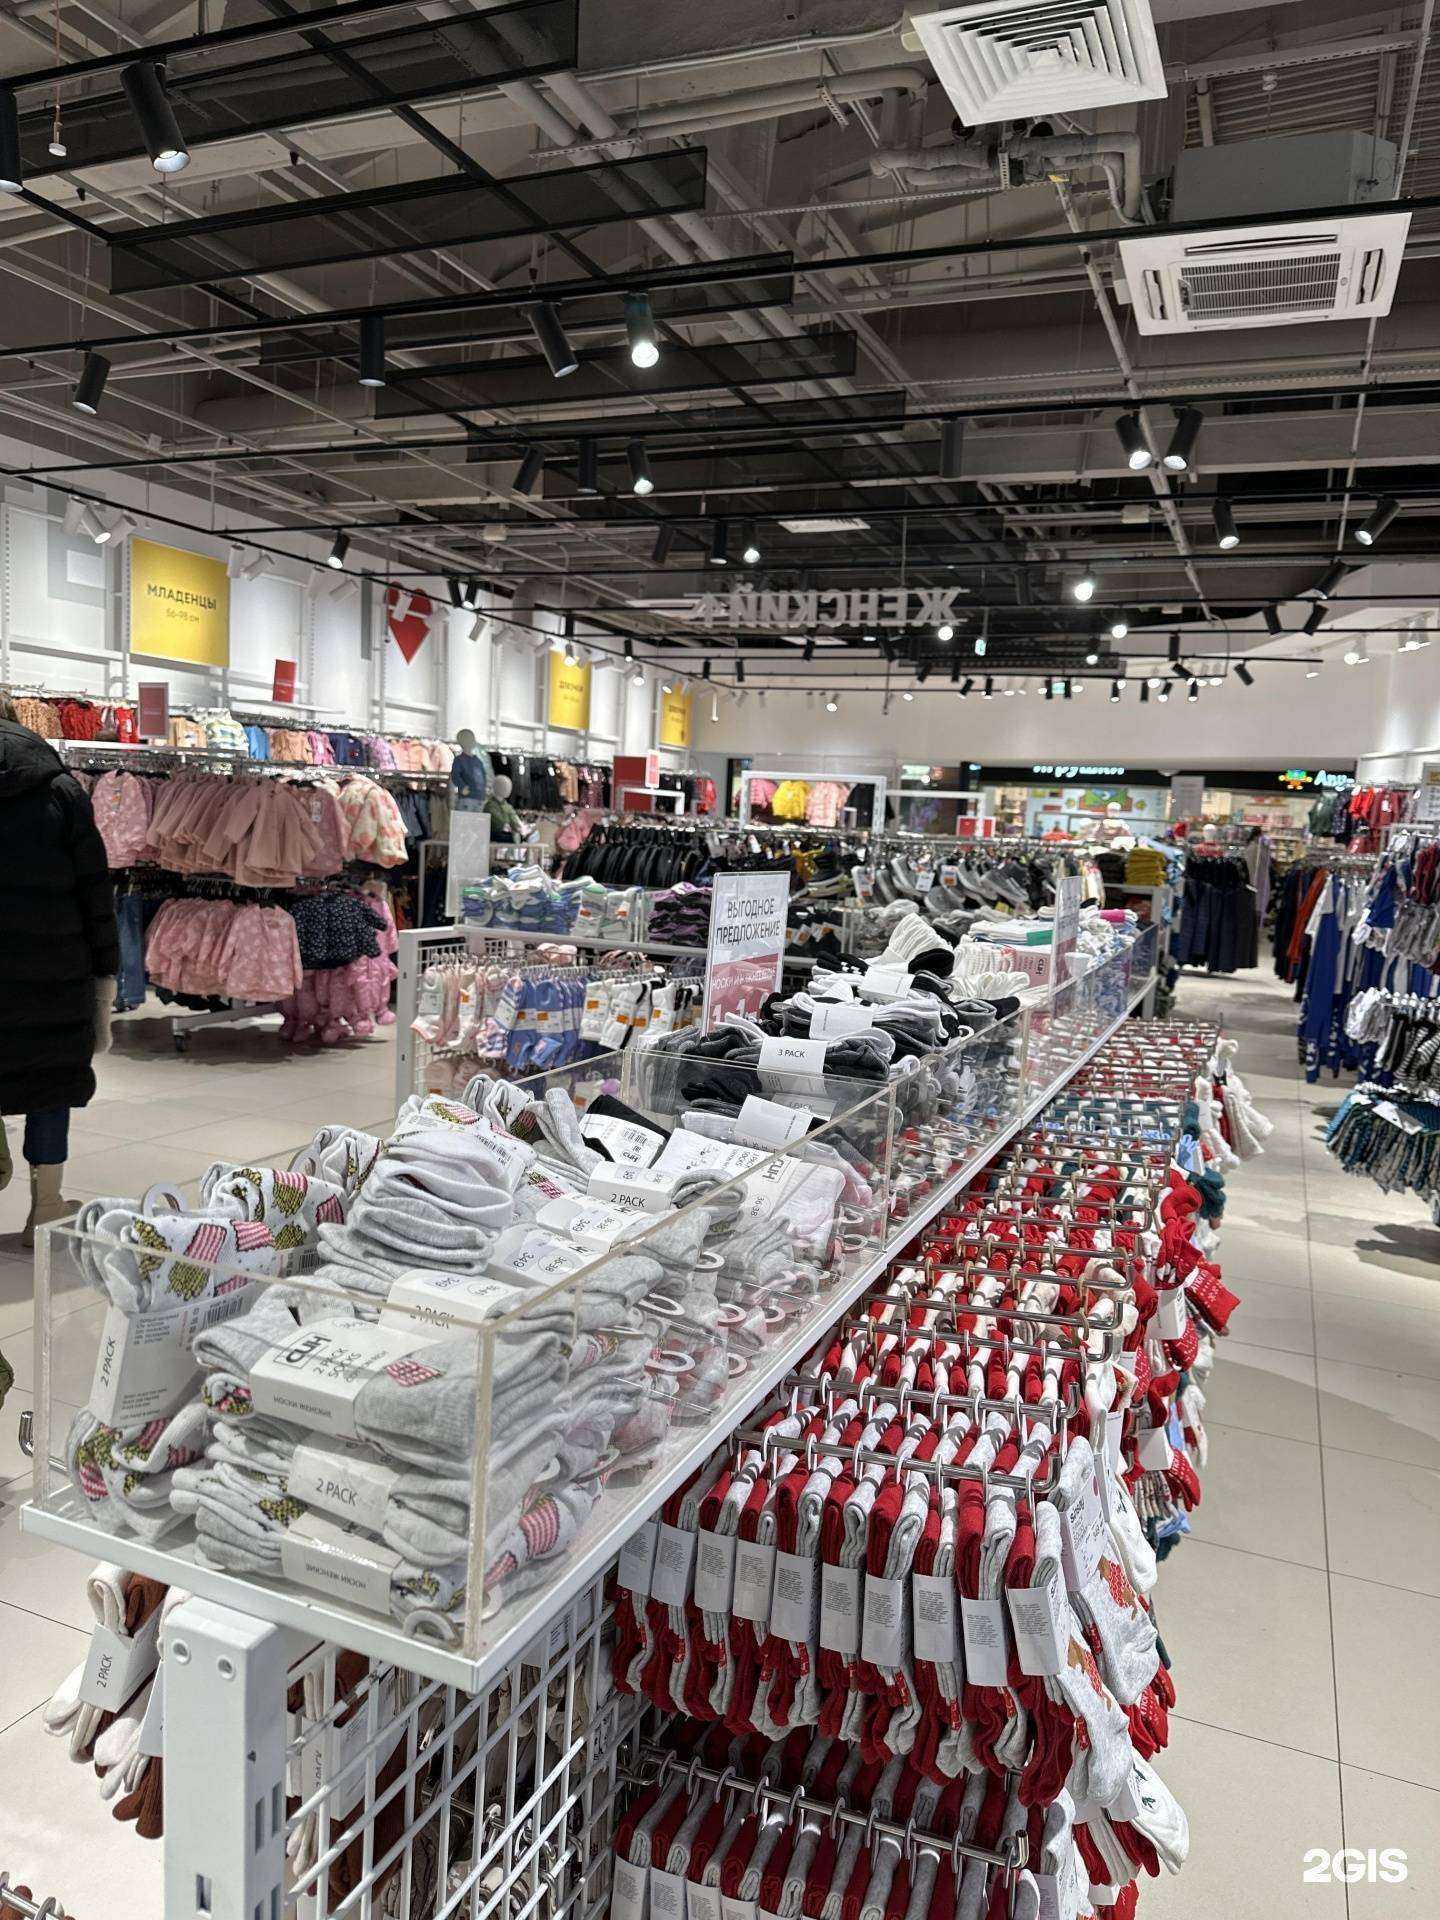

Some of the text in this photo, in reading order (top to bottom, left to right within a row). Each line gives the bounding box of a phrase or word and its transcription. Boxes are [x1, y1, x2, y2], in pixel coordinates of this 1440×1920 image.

[147, 583, 217, 611] МЛАДЕНЦЫ
[727, 898, 775, 919] ВЫГОДНОЕ
[716, 920, 781, 946] ПРЕДЛОЖЕНИЕ
[784, 1049, 806, 1059] PACK
[610, 1193, 646, 1208] 2 PACK
[101, 1336, 115, 1388] 2 PACK
[313, 1348, 348, 1375] 2 PACK
[328, 1353, 362, 1379] SOCKS
[316, 1477, 358, 1506] 2 PACK
[96, 1654, 113, 1688] 2 PACK
